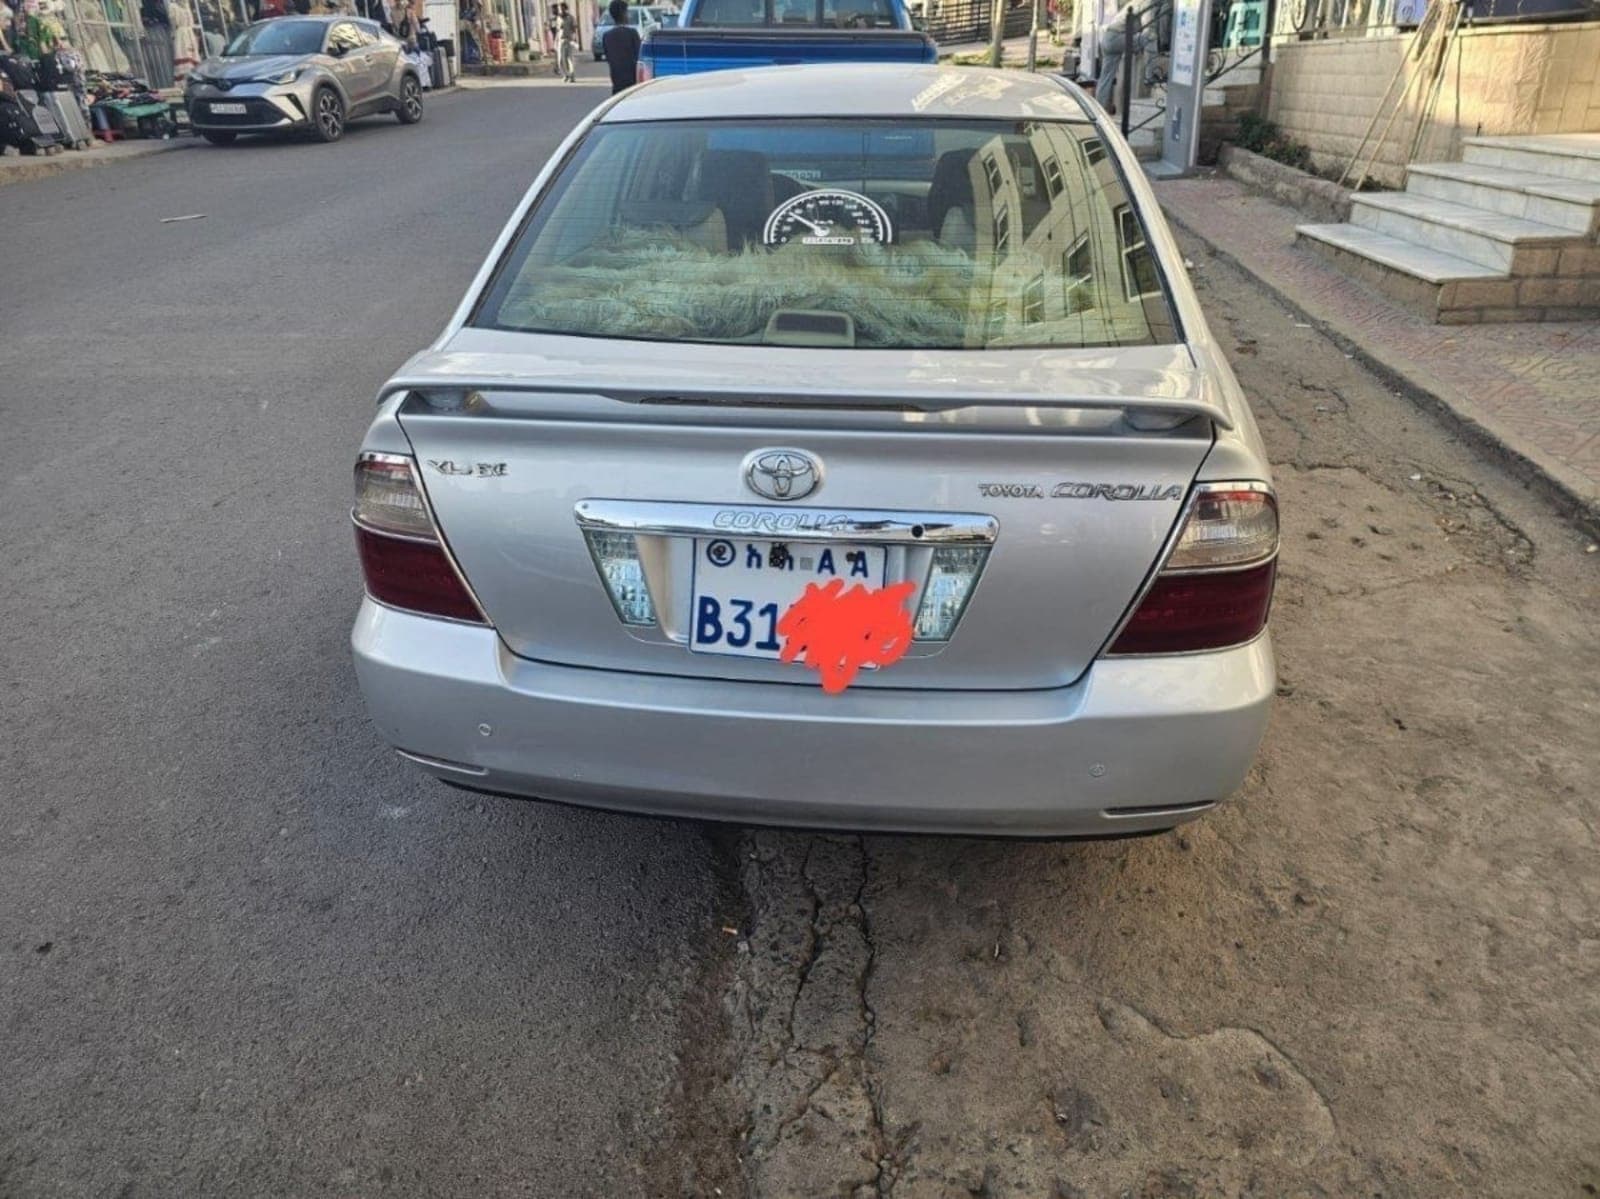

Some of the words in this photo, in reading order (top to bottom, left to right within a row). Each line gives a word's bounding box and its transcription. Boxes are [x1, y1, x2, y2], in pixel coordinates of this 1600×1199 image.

[977, 483, 1044, 500] TOYOTA
[1050, 481, 1184, 502] COROLLA
[712, 510, 849, 532] COROLLA
